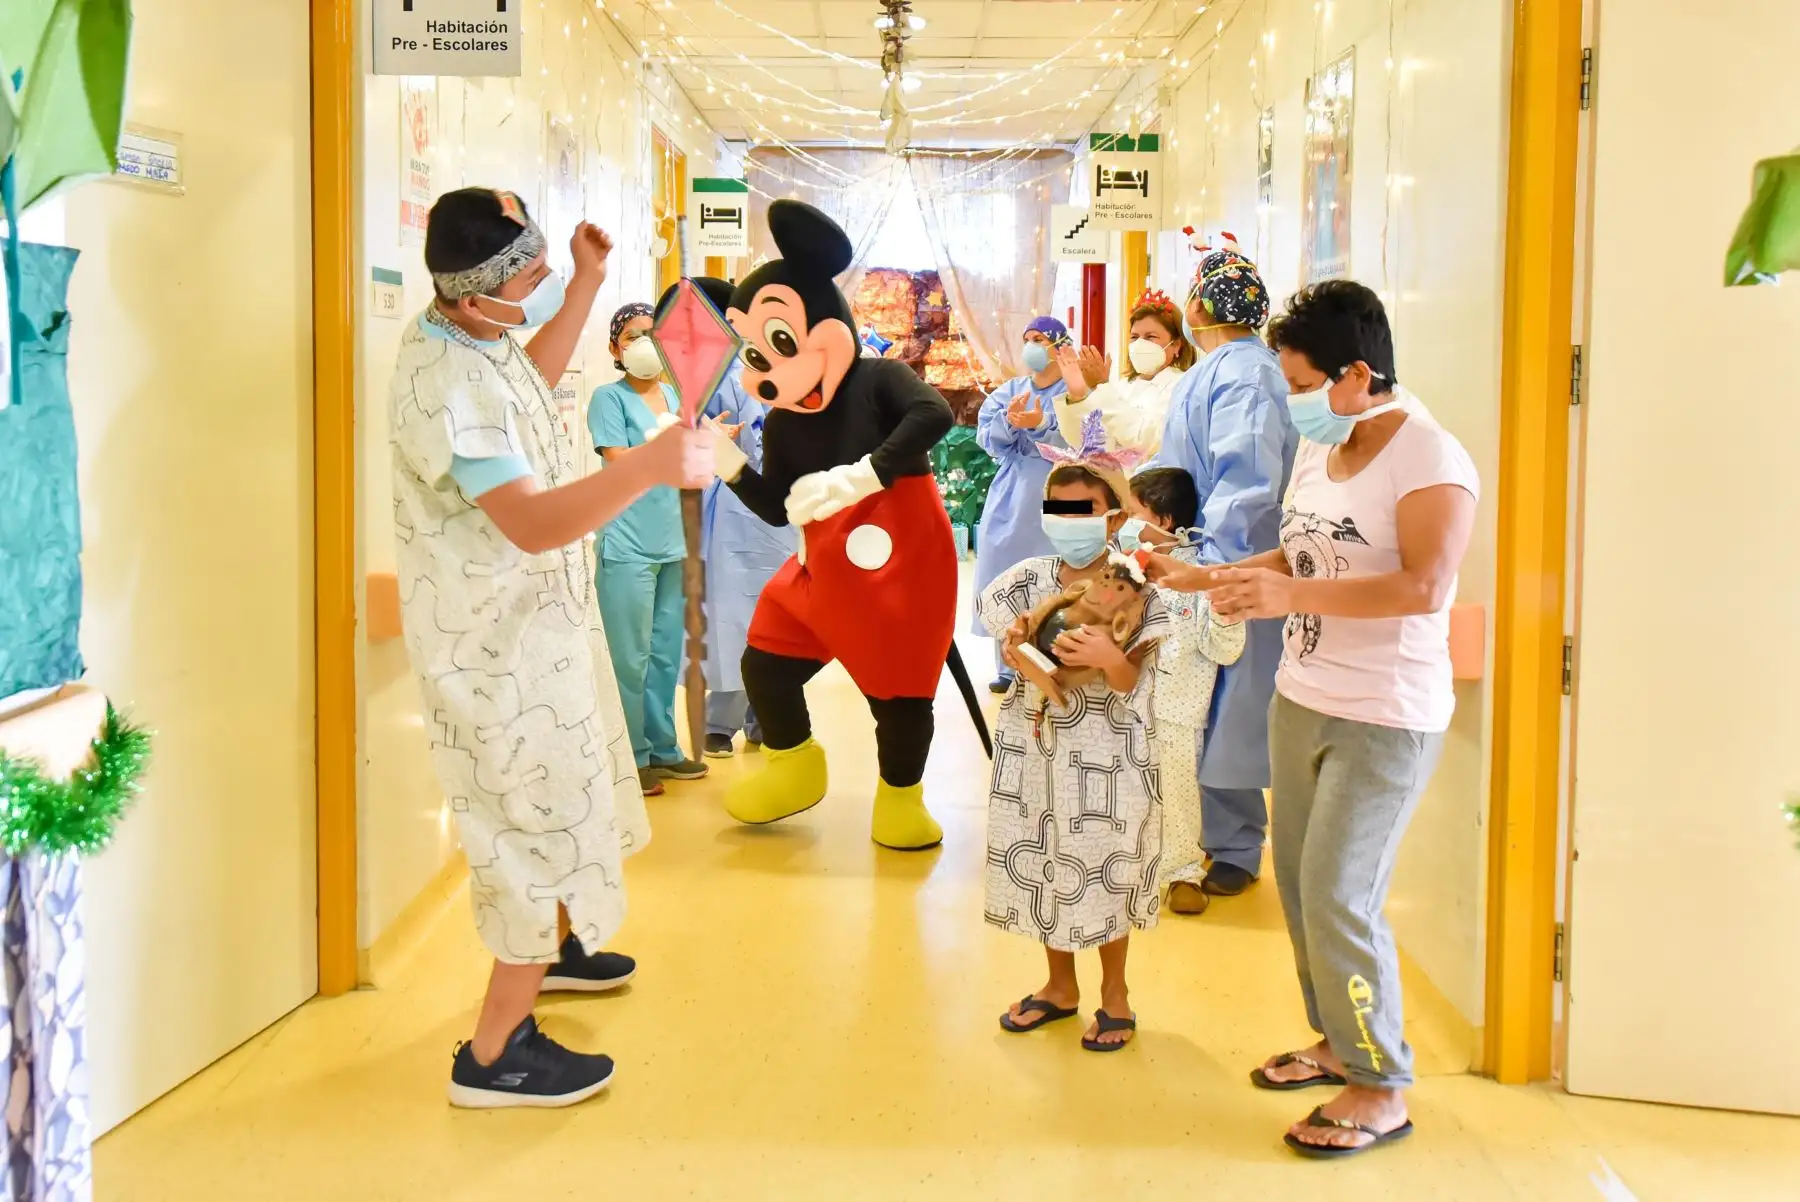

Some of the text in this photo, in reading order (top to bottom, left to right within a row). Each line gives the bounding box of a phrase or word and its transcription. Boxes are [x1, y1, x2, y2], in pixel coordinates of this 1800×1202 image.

[426, 20, 508, 33] Habitación
[391, 37, 417, 50] Pre
[432, 38, 508, 51] Escolares
[1062, 247, 1096, 255] Escalera
